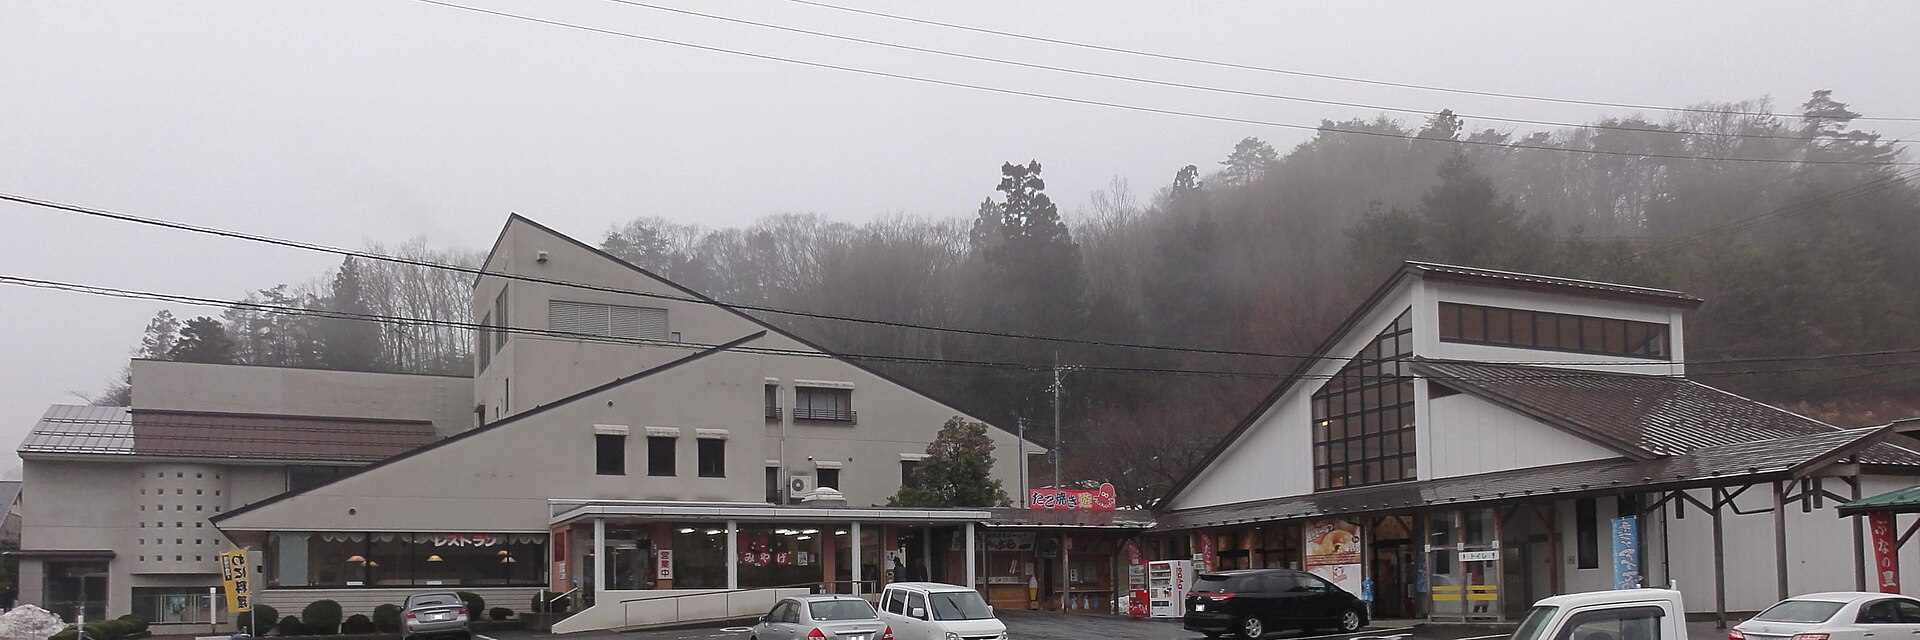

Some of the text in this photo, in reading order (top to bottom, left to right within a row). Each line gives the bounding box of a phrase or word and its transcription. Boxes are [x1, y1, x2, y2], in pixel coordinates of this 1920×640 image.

[434, 533, 496, 547] レストラン
[660, 551, 670, 577] 営業中
[738, 552, 787, 563] みやげ
